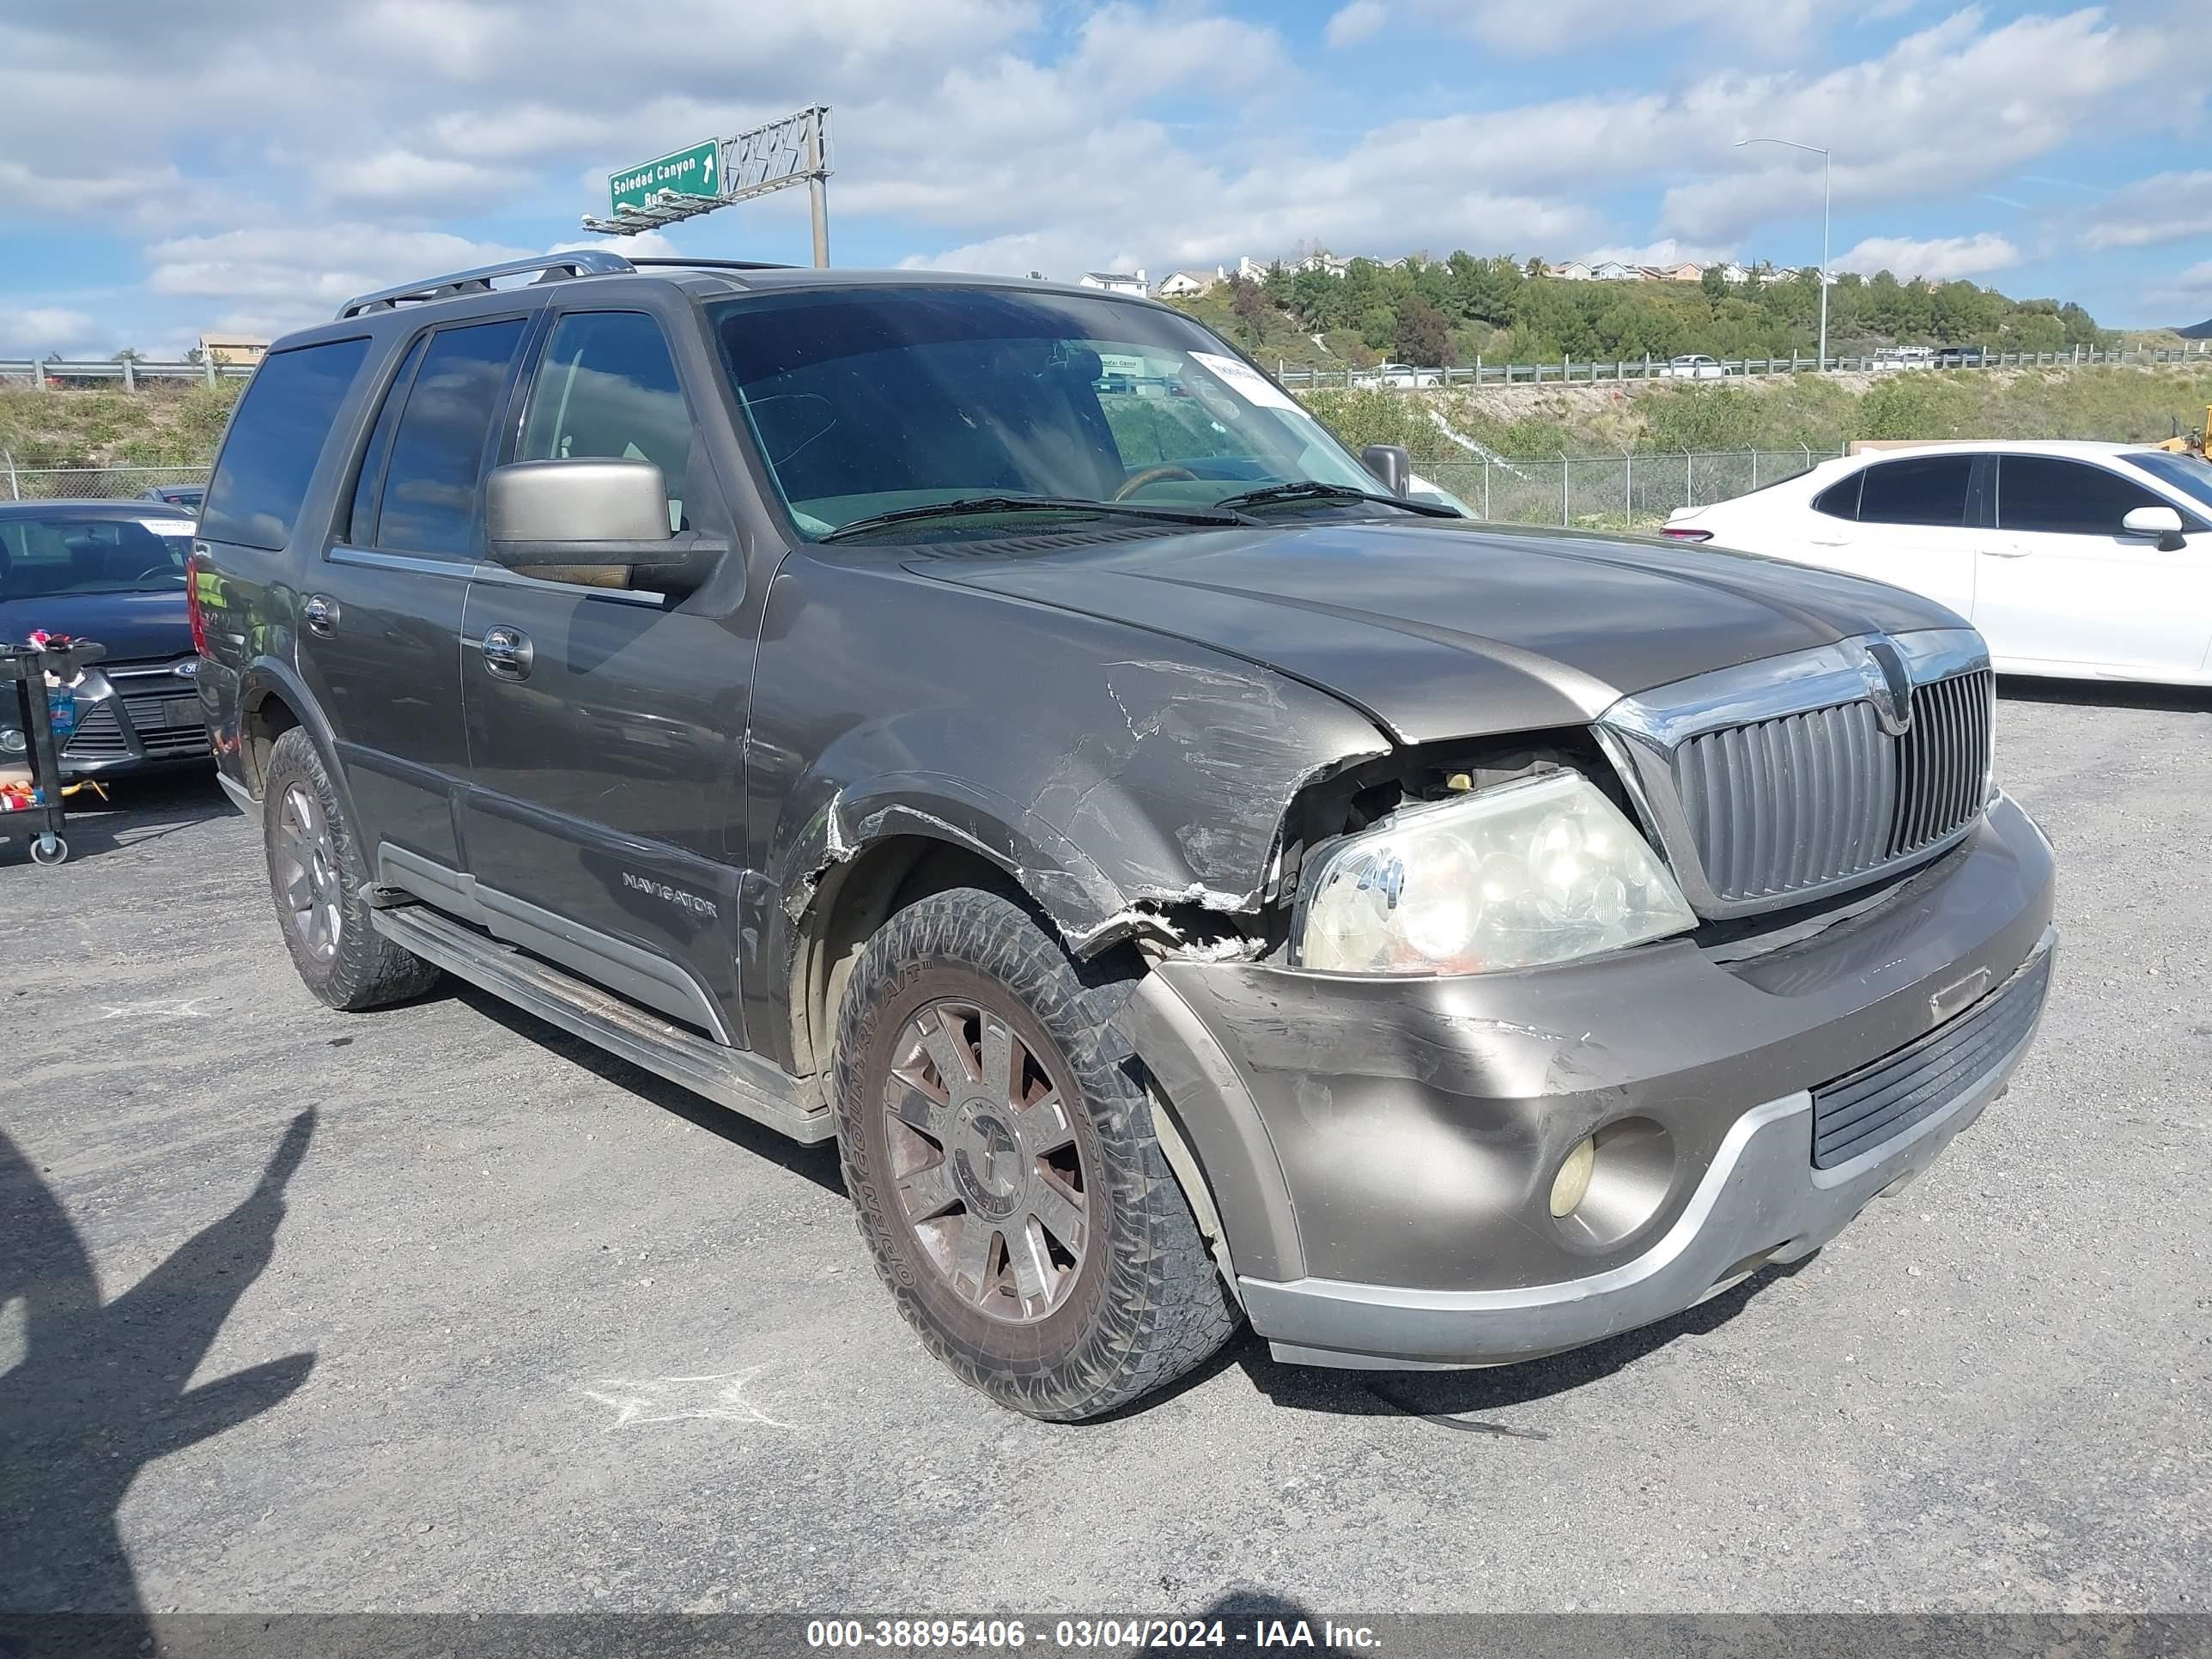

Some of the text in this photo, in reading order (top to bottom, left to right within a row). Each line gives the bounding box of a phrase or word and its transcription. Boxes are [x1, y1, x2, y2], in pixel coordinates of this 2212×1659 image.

[613, 157, 696, 196] Soledad Canyon
[644, 188, 668, 207] Roa
[622, 872, 718, 919] NAVIGATOR
[848, 1003, 880, 1176] COUNTRY
[1077, 1097, 1109, 1234] TOYO
[861, 1184, 916, 1286] OPEN
